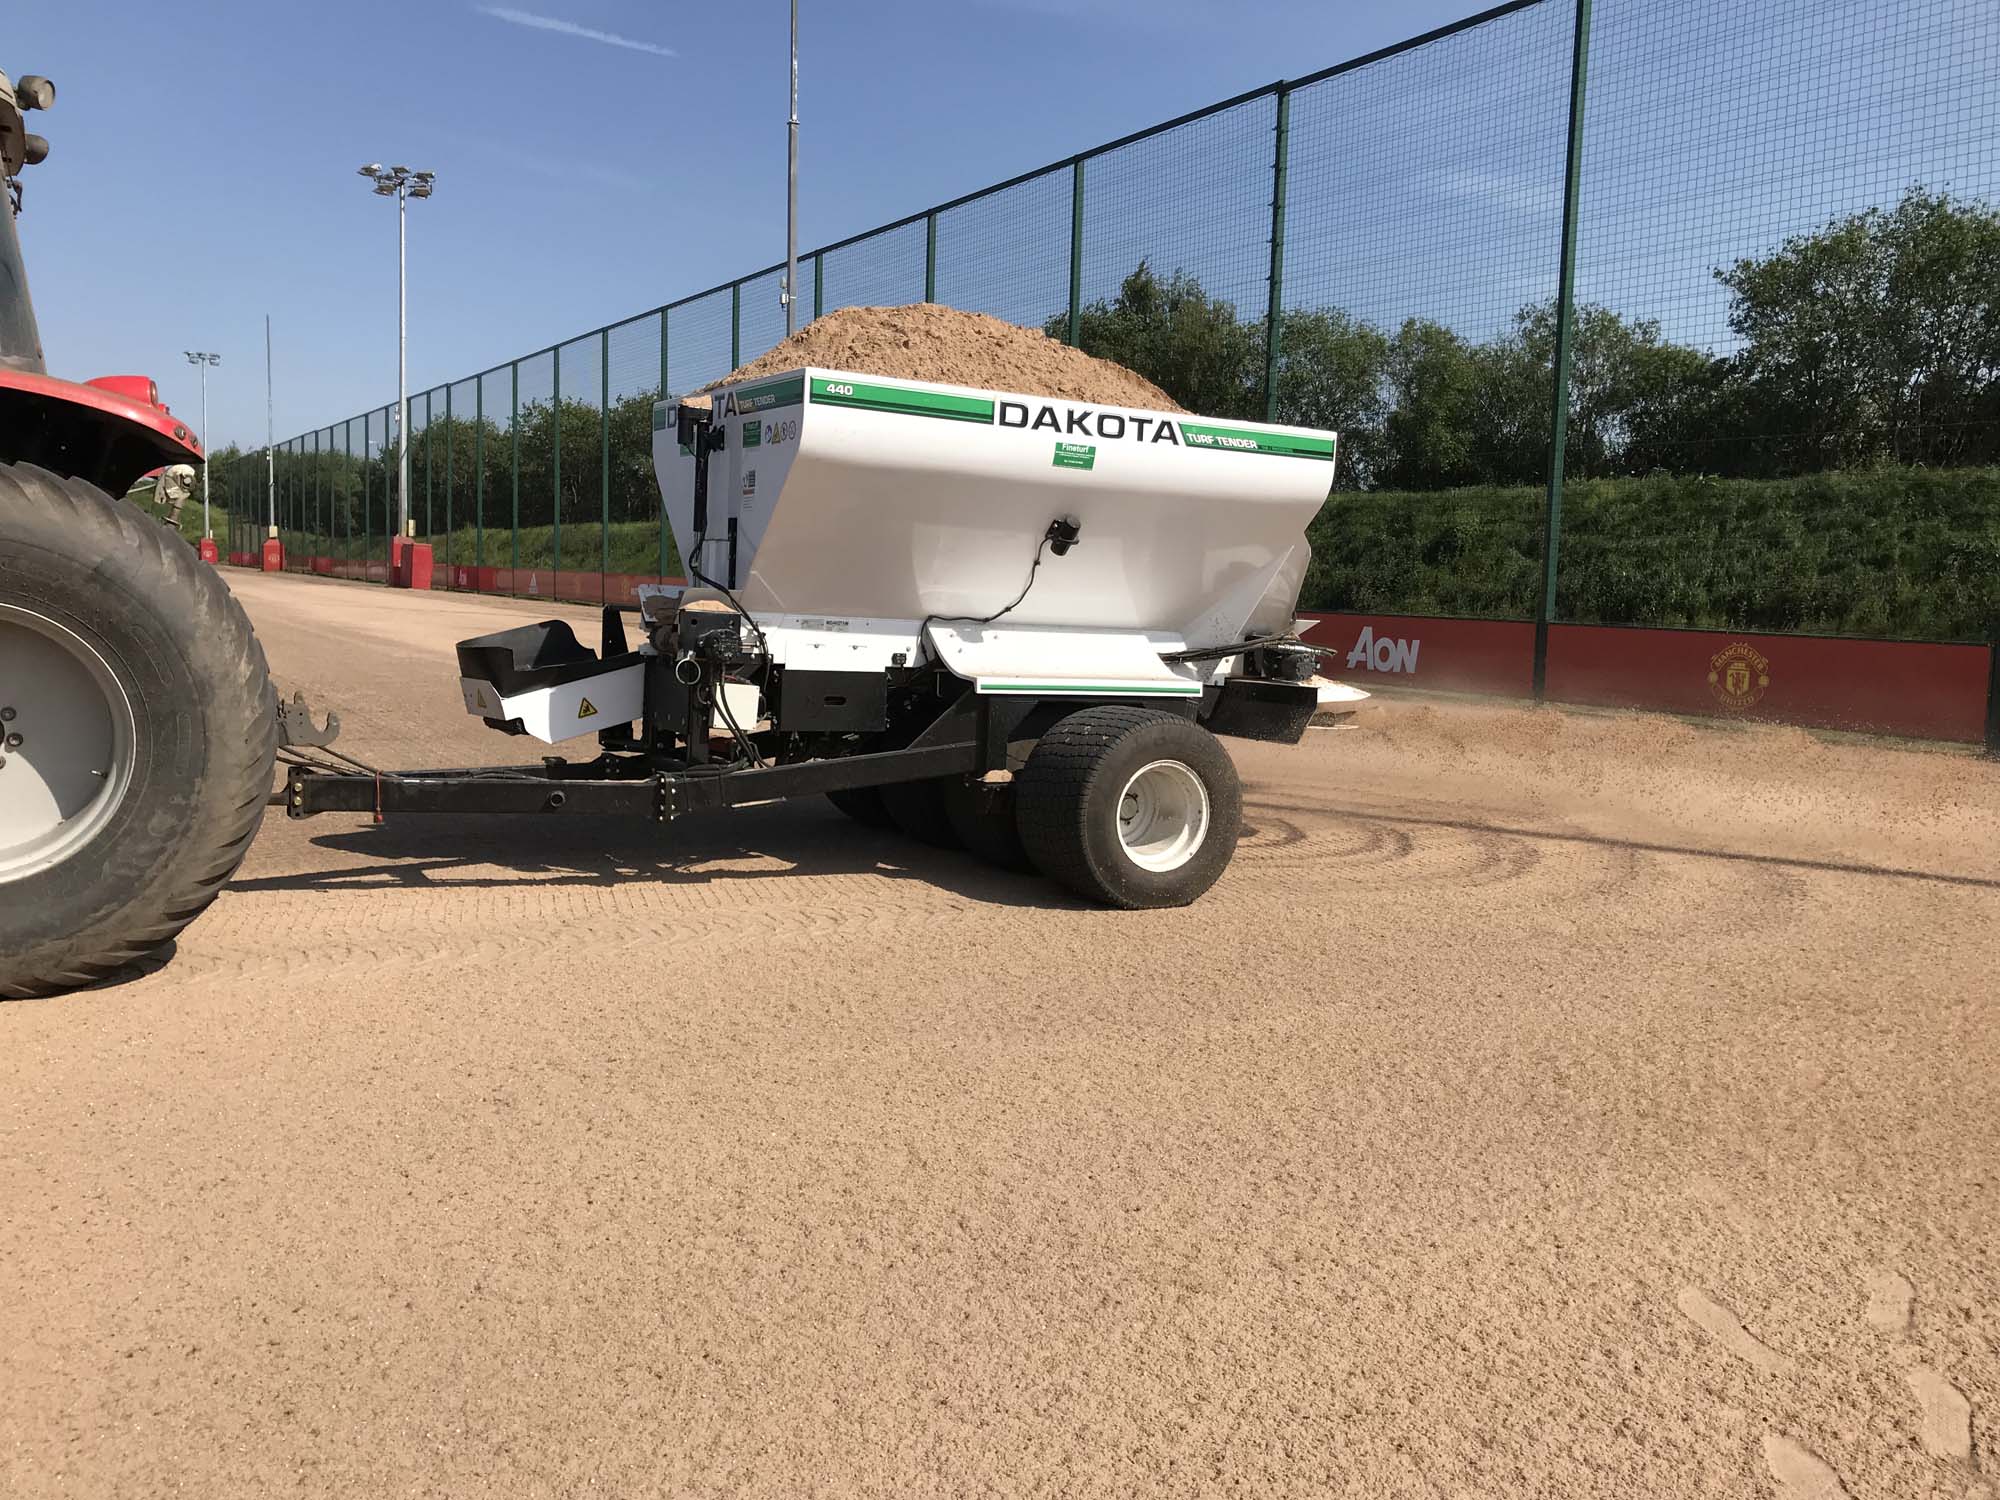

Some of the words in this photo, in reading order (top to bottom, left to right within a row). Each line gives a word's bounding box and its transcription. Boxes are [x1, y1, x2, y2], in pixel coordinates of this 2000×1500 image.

[826, 383, 853, 396] 440
[754, 394, 777, 406] TENDER
[999, 400, 1180, 446] DAKOTA
[1186, 433, 1214, 445] TURF
[1216, 436, 1258, 449] TENDER
[1062, 443, 1089, 454] Fineturf
[1714, 647, 1764, 669] MANCHESTER
